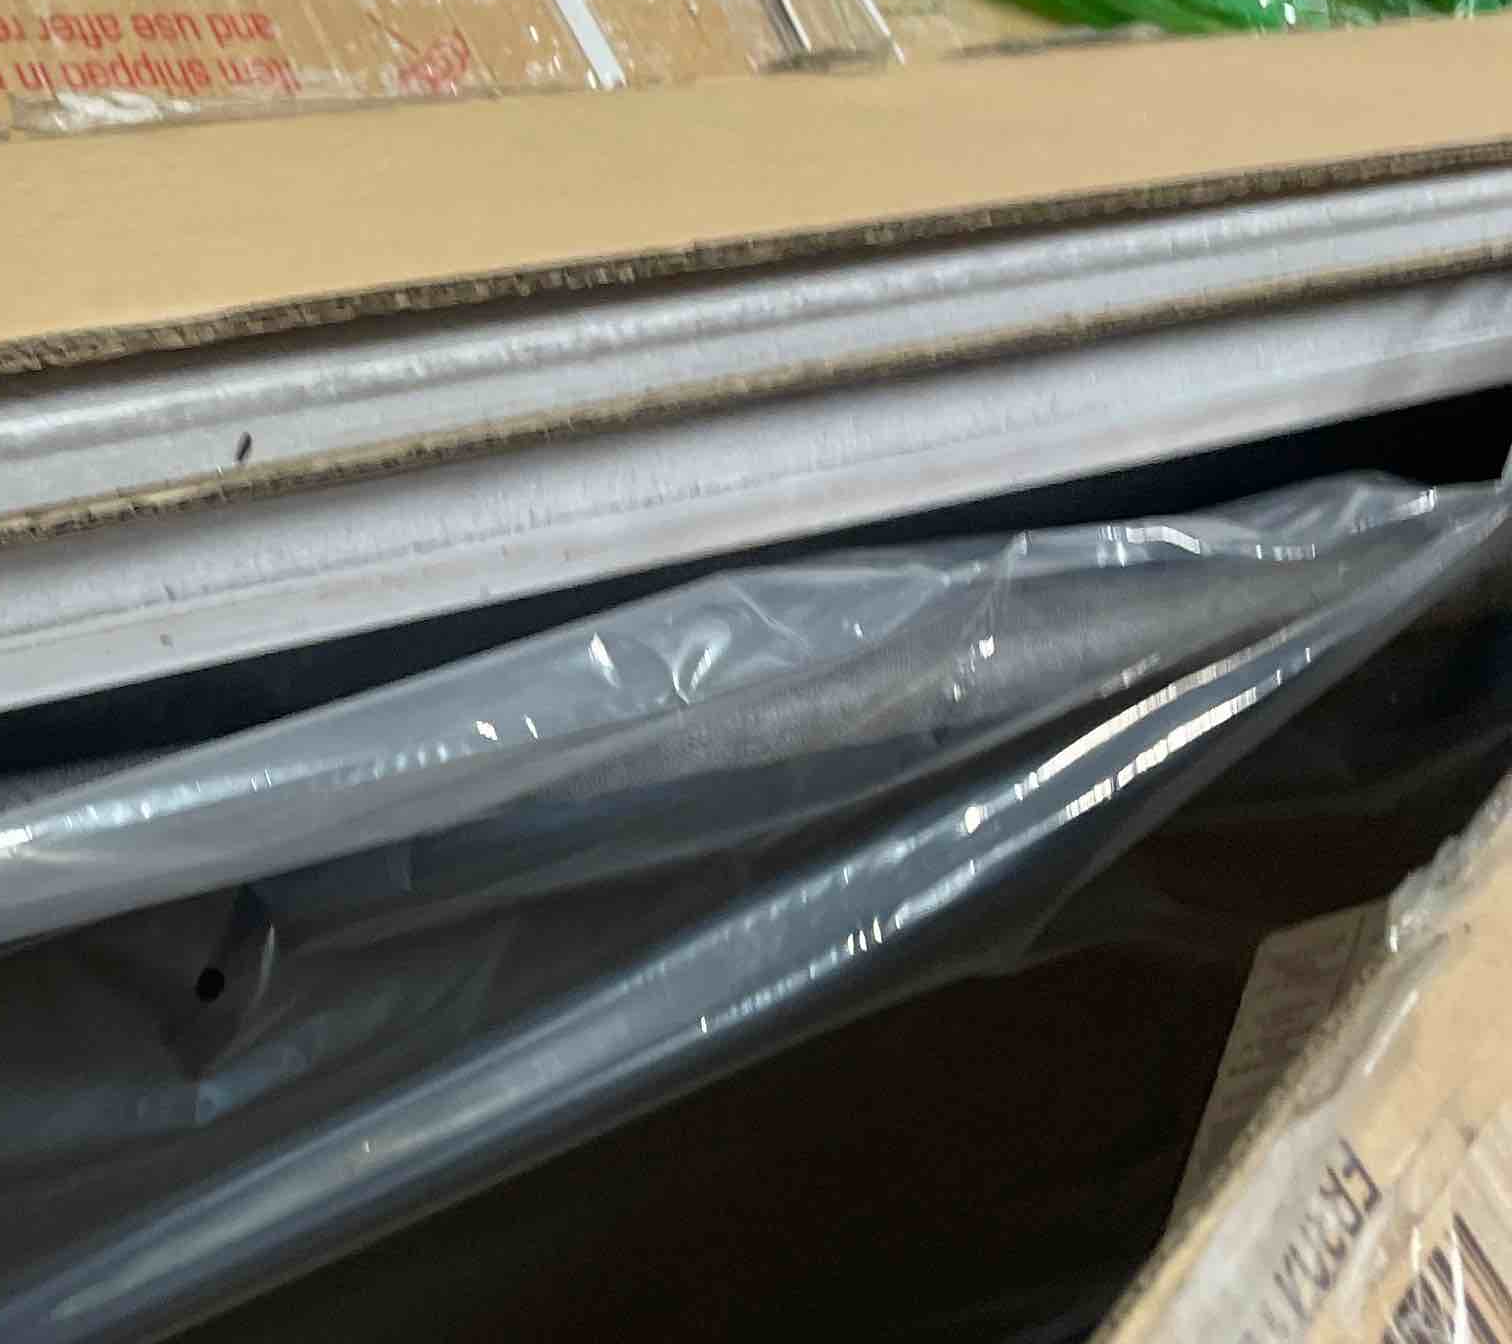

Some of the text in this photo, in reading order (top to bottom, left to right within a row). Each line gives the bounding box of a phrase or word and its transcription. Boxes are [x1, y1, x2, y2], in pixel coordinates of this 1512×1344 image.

[39, 12, 120, 51] after
[132, 12, 200, 43] use
[211, 12, 276, 49] and
